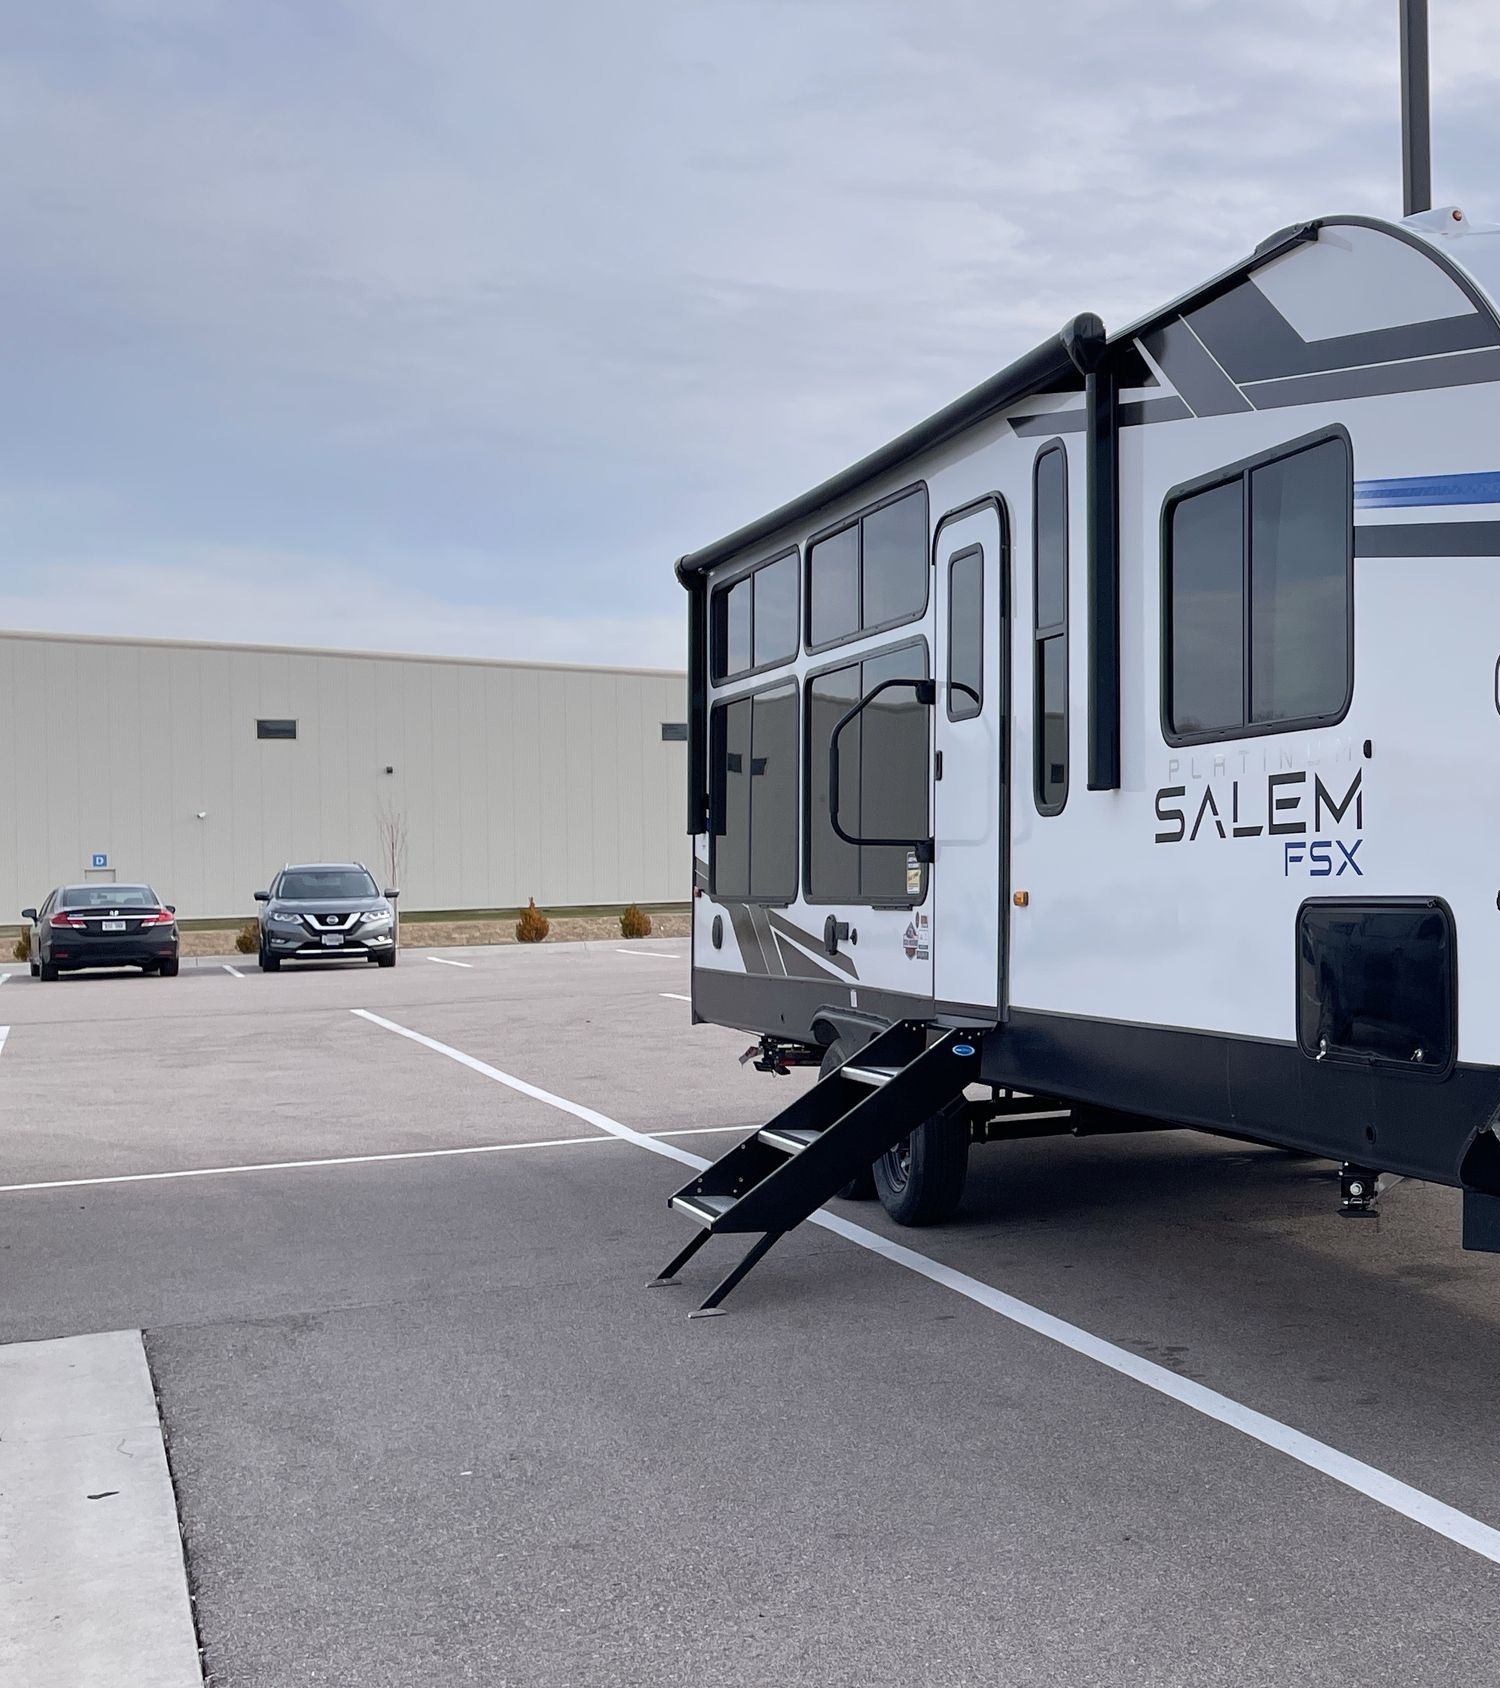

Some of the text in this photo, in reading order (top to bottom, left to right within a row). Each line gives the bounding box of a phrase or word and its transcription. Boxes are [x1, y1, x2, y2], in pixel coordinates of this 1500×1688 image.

[1168, 737, 1353, 783] PLATINUM
[1154, 767, 1363, 844] SALEM
[96, 856, 104, 866] D
[1284, 838, 1364, 877] FSX
